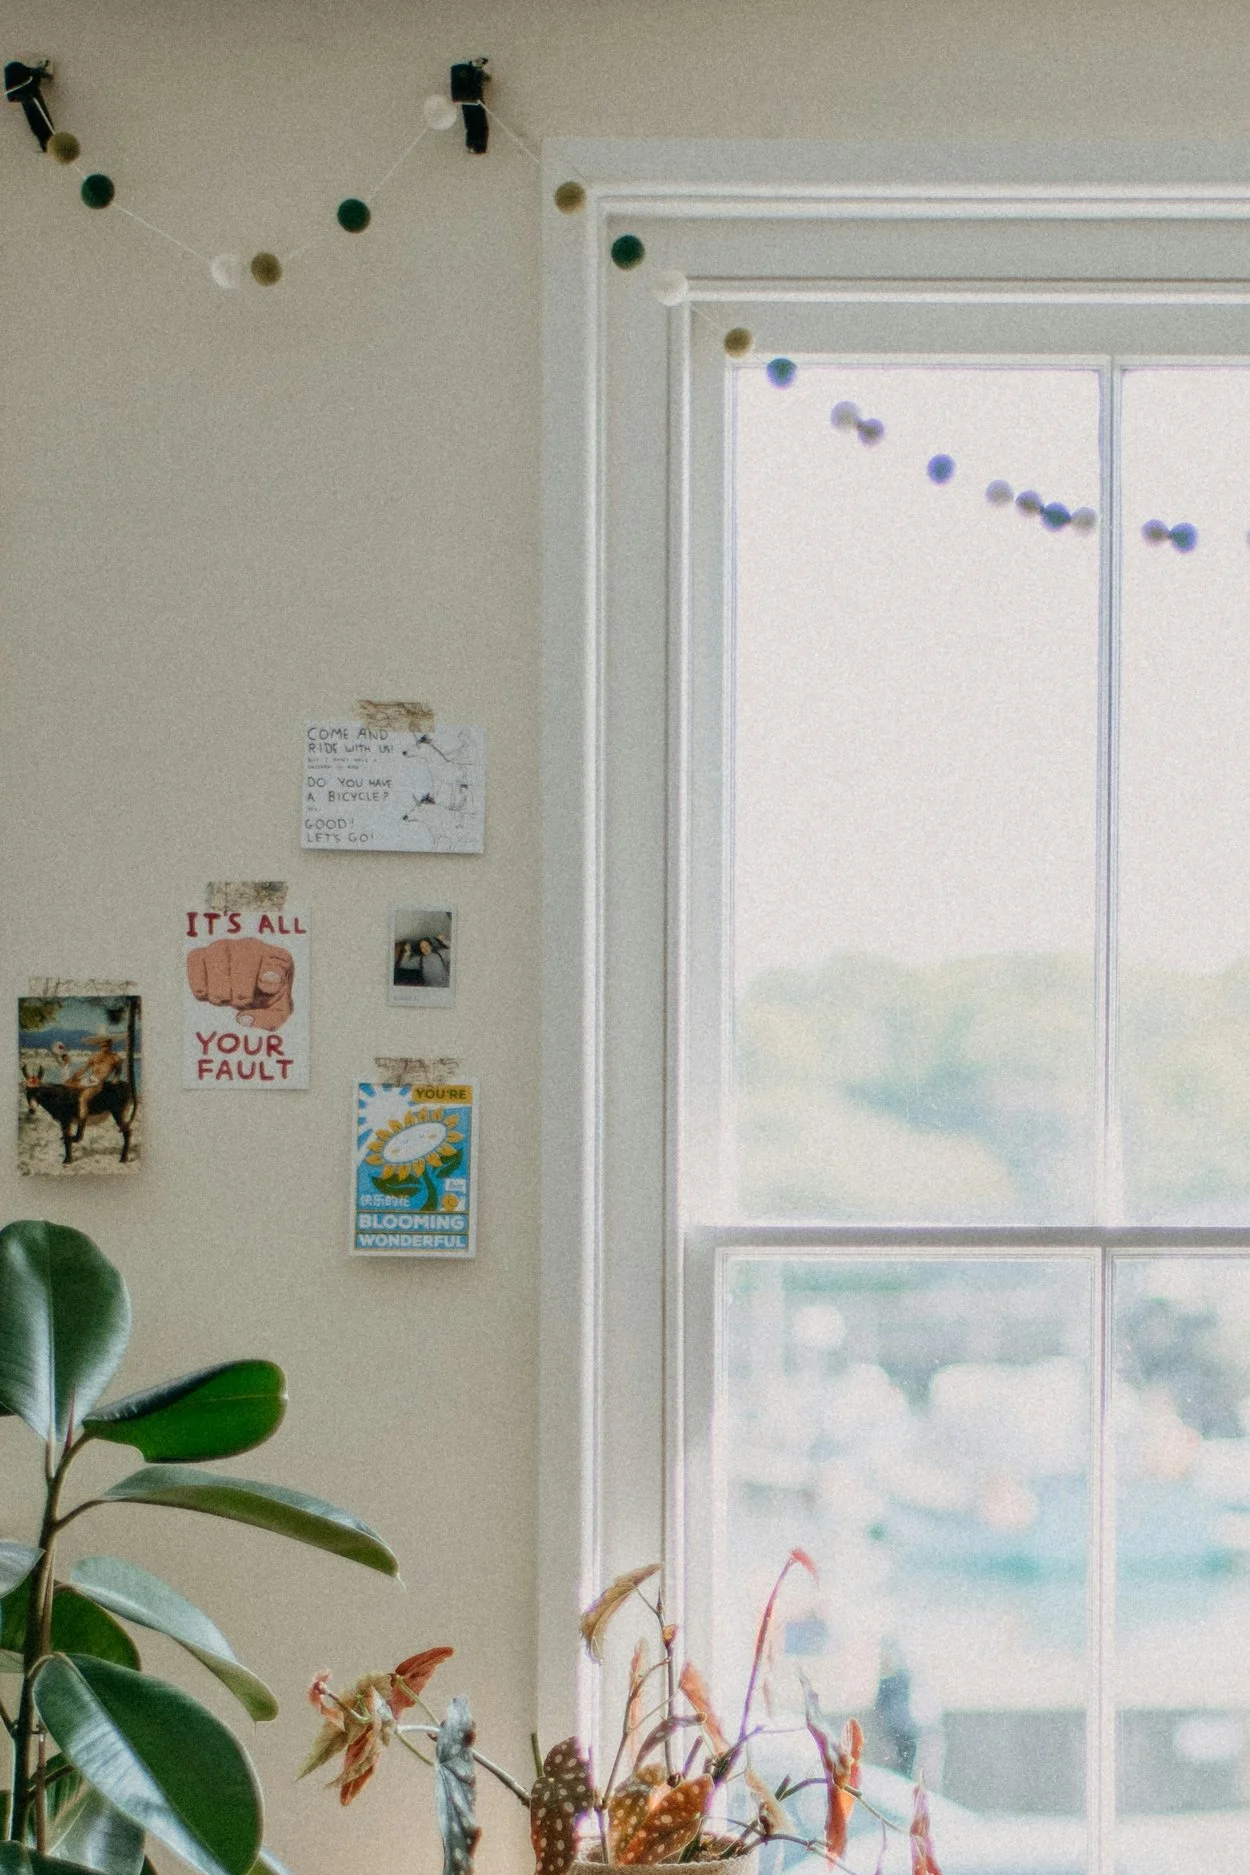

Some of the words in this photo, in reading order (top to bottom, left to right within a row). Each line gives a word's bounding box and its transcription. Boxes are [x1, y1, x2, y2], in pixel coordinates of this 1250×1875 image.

[307, 727, 348, 740] COME
[357, 727, 388, 740] AND
[308, 742, 338, 754] RIDE
[344, 743, 371, 753] WITH
[307, 776, 326, 788] DO
[337, 777, 363, 788] YOU
[368, 779, 392, 788] HAVE
[307, 792, 315, 802] A
[328, 790, 389, 802] BICYCLE?
[304, 818, 354, 830] GOOD!
[186, 912, 242, 937] IT'S
[258, 914, 307, 934] ALL
[196, 1031, 285, 1056] YOUR
[197, 1058, 294, 1081] FAULT
[415, 1088, 467, 1100] YOU'RE
[359, 1214, 465, 1230] BLOOMING
[359, 1234, 467, 1248] WONDERFUL
